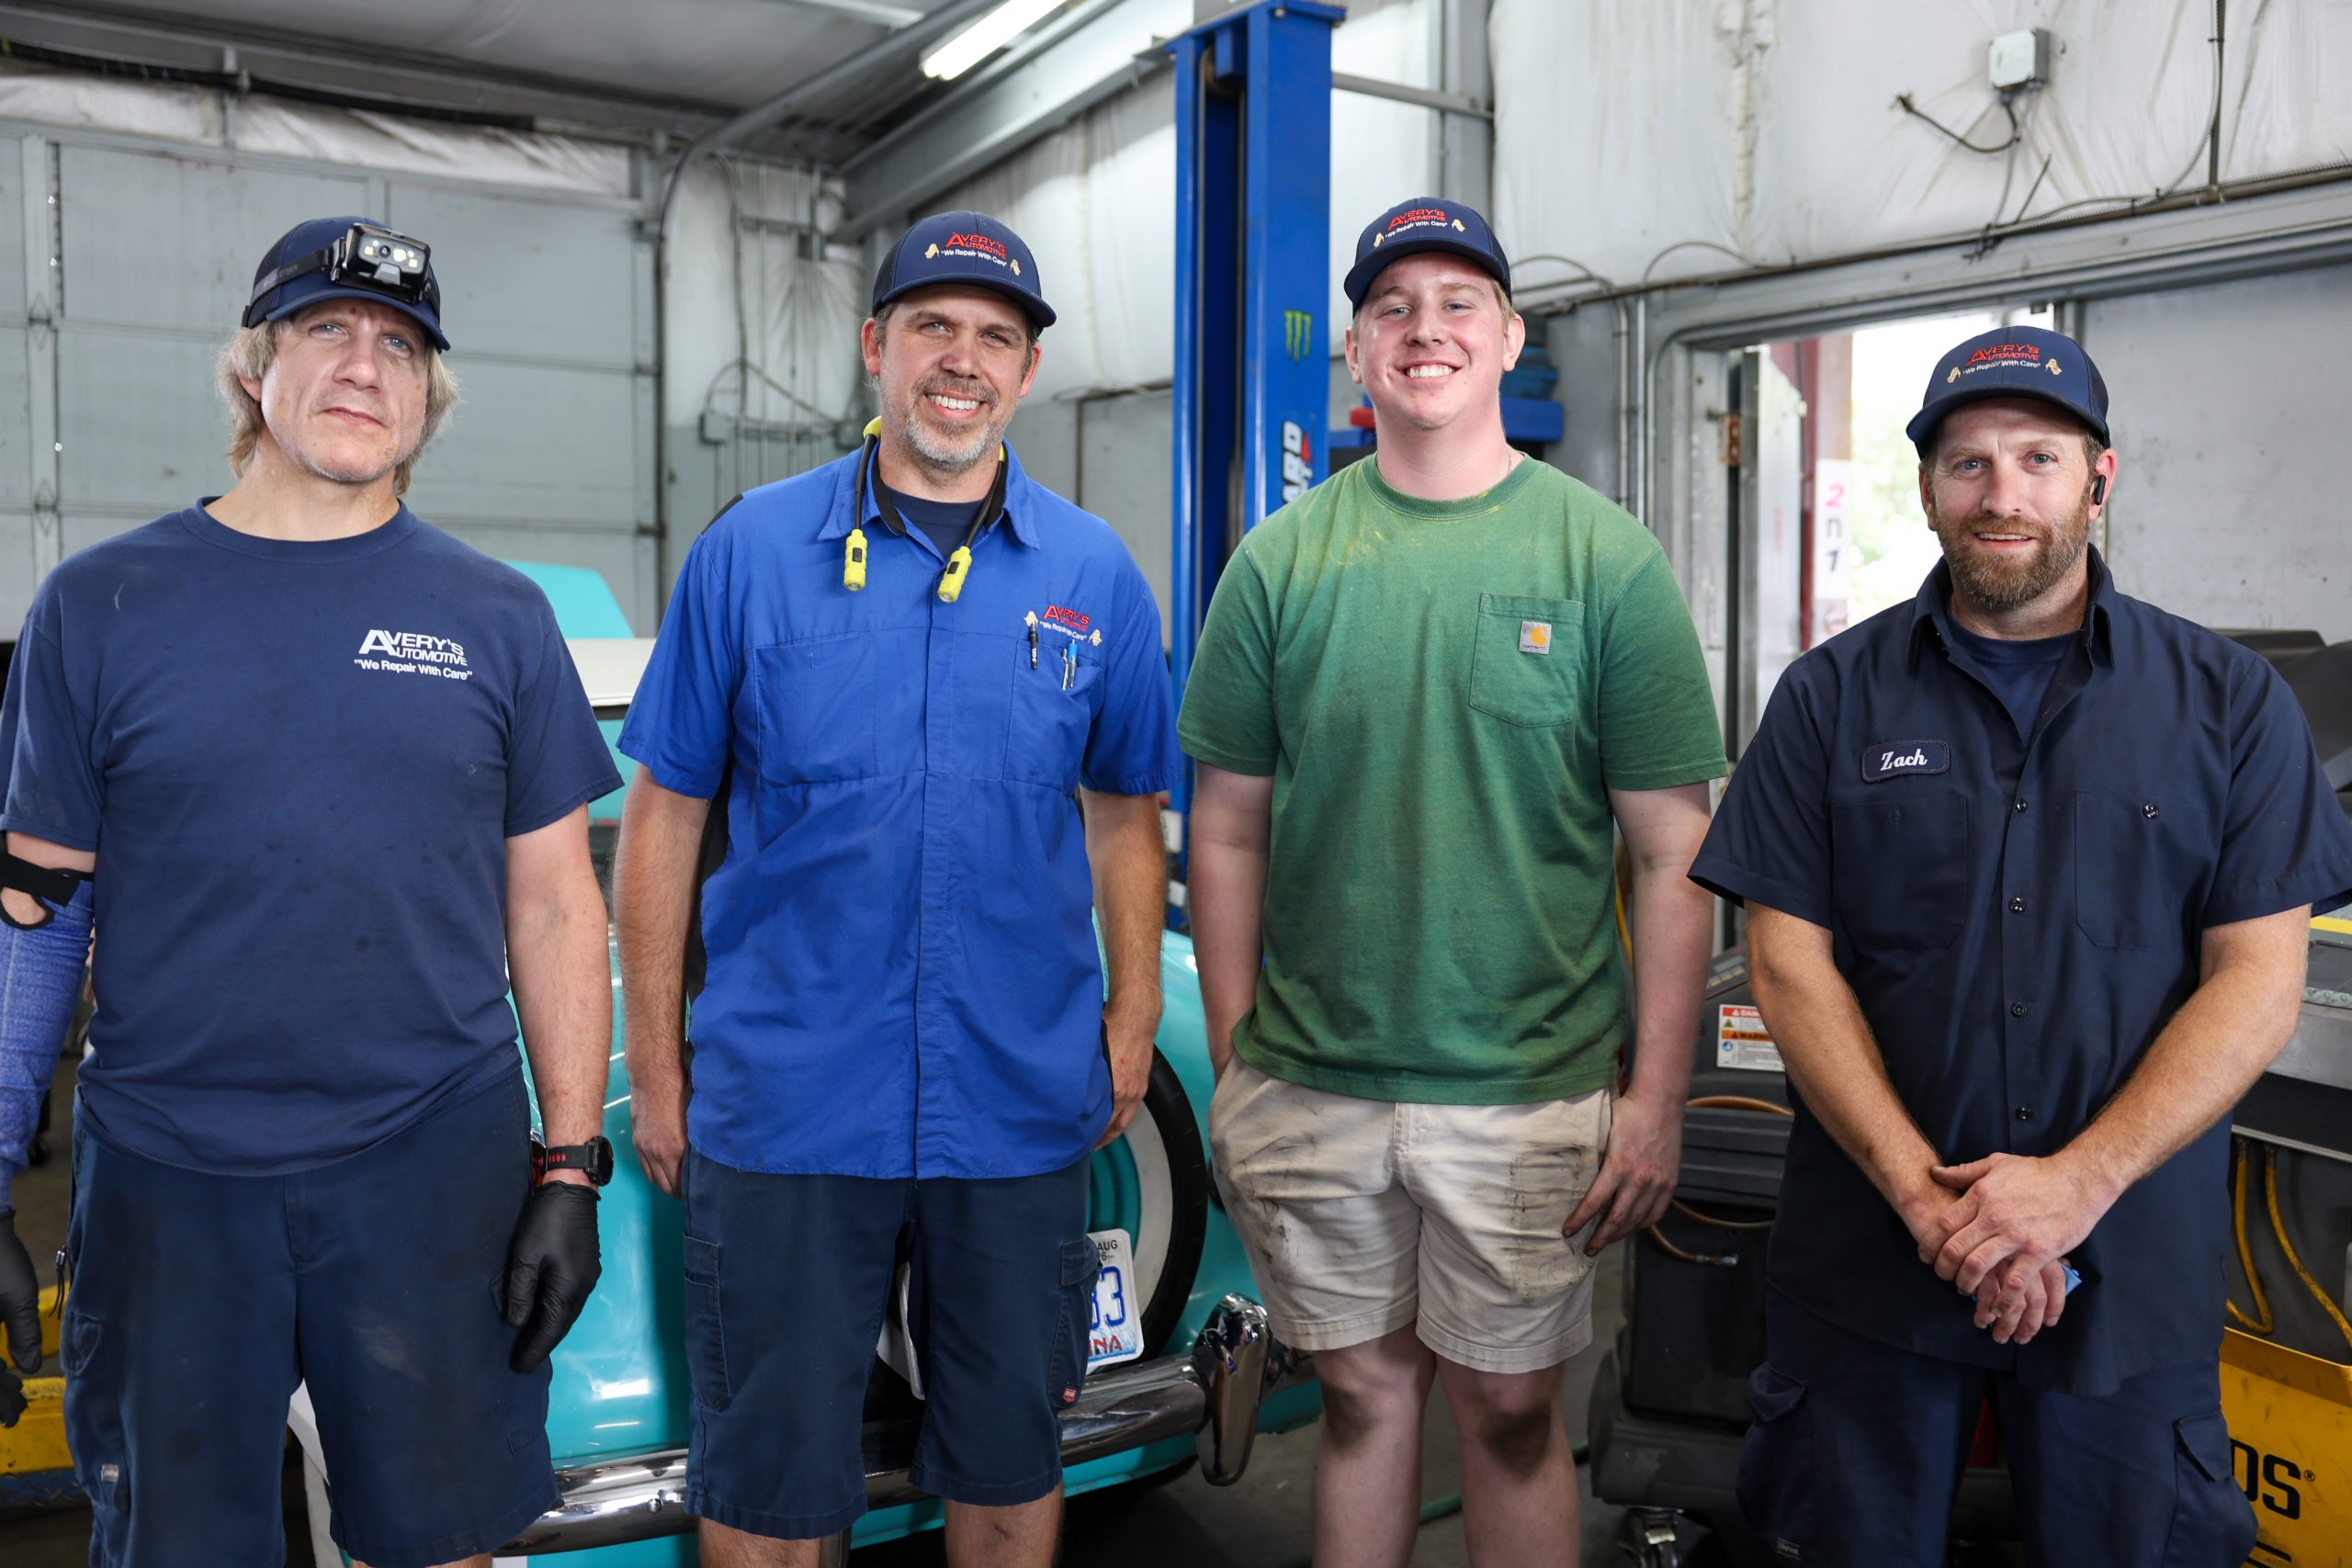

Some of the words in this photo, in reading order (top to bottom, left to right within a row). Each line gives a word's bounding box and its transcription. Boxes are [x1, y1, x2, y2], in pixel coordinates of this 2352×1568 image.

[1387, 209, 1446, 231] AVERY'S
[944, 231, 1006, 253] AVERY'S
[955, 248, 977, 257] Repair
[977, 251, 992, 261] With
[1966, 344, 2041, 367] AVERY'S
[2000, 359, 2019, 367] With
[358, 628, 465, 656] AVERY'S
[380, 660, 417, 673] Repair
[417, 663, 442, 677] With
[1880, 748, 1928, 772] Zach
[1097, 1239, 1118, 1251] AUG
